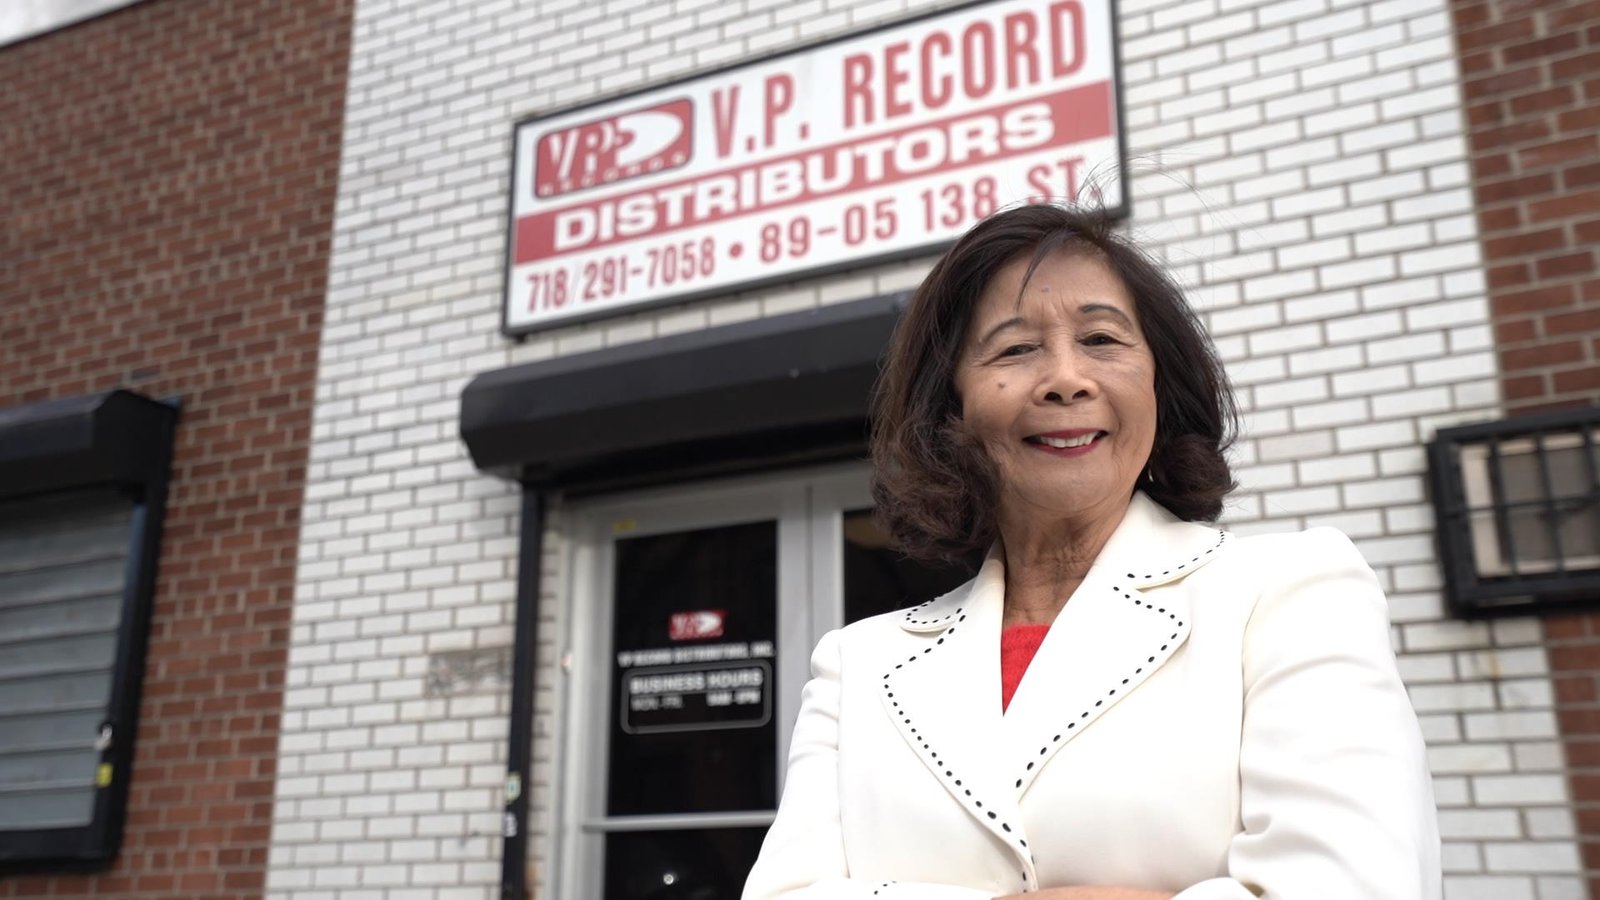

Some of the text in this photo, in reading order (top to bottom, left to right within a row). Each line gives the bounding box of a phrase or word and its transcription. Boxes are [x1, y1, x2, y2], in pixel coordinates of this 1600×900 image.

[710, 0, 1087, 159] V.P. RECORD
[526, 236, 716, 313] 718/291-7058
[760, 197, 898, 264] 89-05
[920, 176, 999, 232] 138
[553, 101, 1056, 252] DISTRIBUTORS
[630, 667, 763, 694] BUSINESS HOURS
